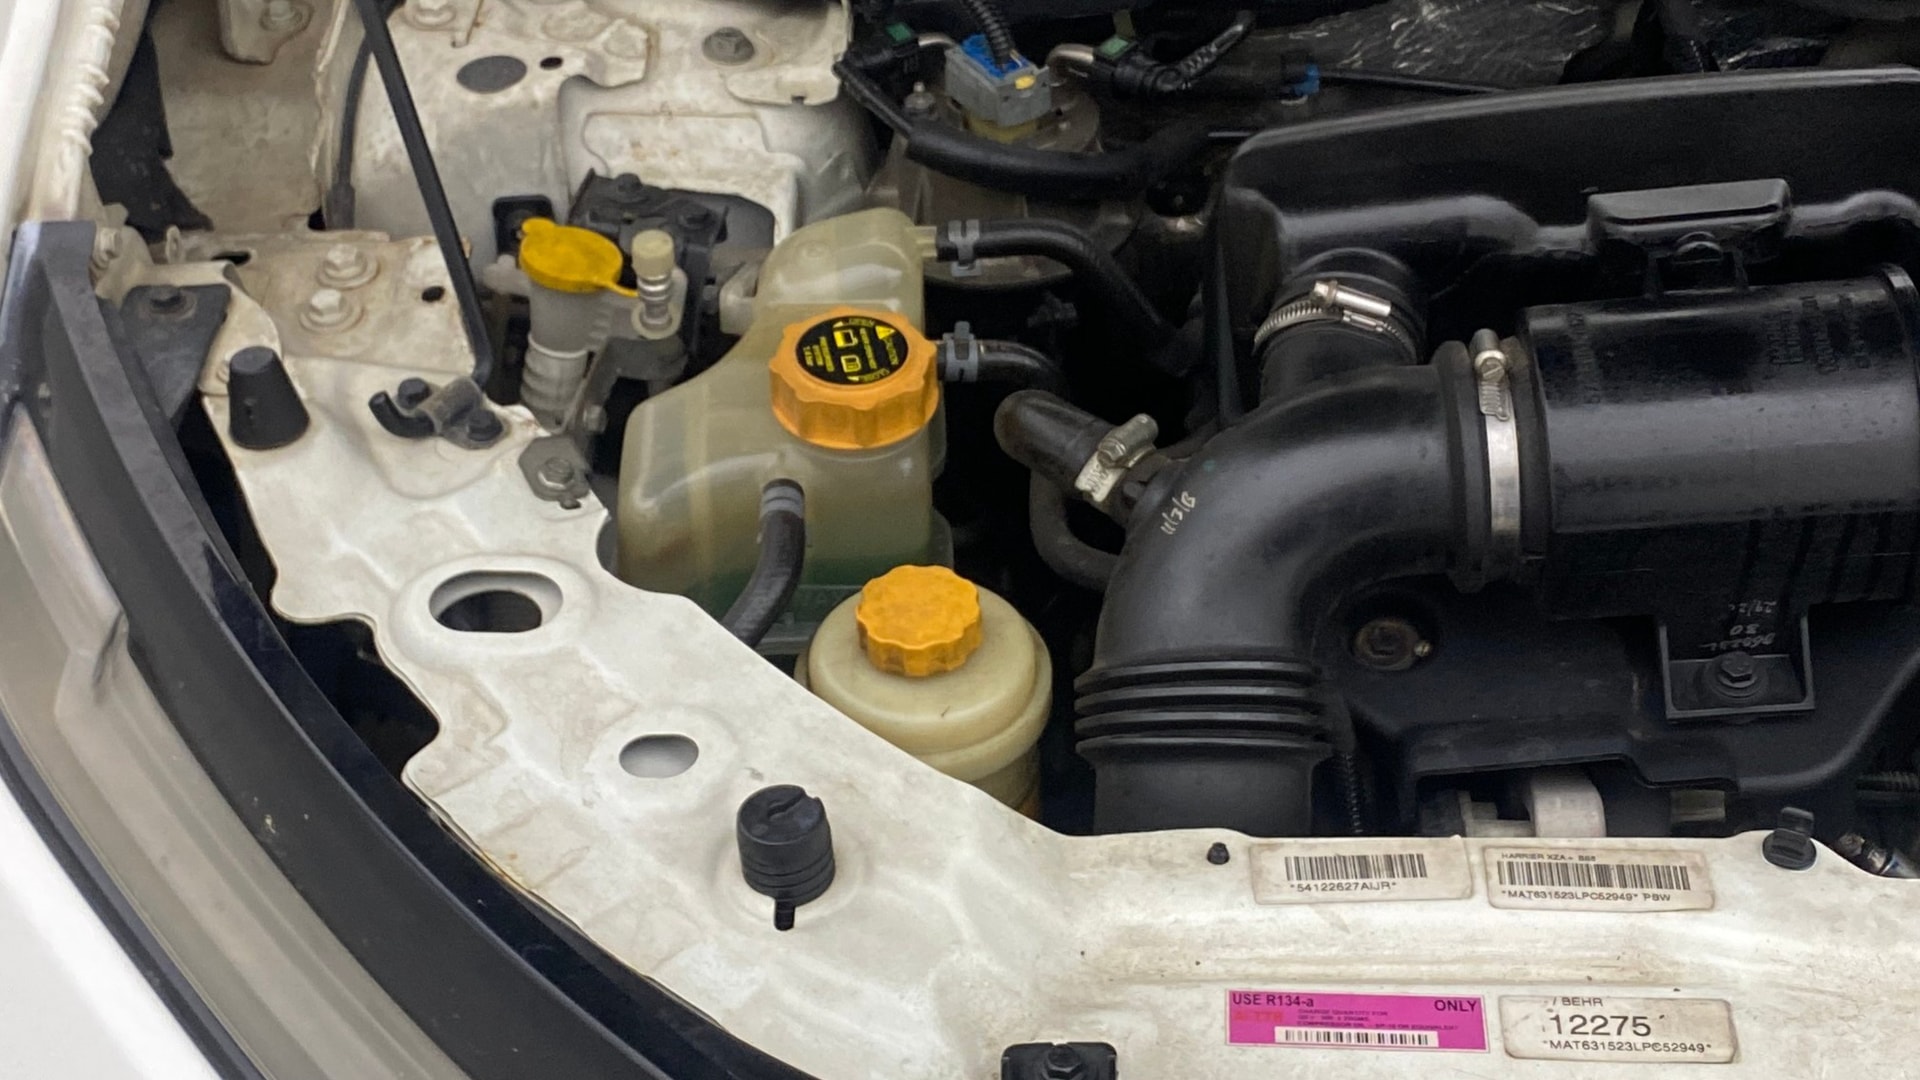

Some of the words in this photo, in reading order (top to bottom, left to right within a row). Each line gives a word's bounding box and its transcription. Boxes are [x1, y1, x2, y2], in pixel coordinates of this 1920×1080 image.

[1232, 993, 1262, 1006] USE
[1266, 994, 1314, 1007] R134-a
[1434, 999, 1477, 1012] ONLY
[1562, 997, 1603, 1007] BEHR
[1549, 1014, 1651, 1037] 12275
